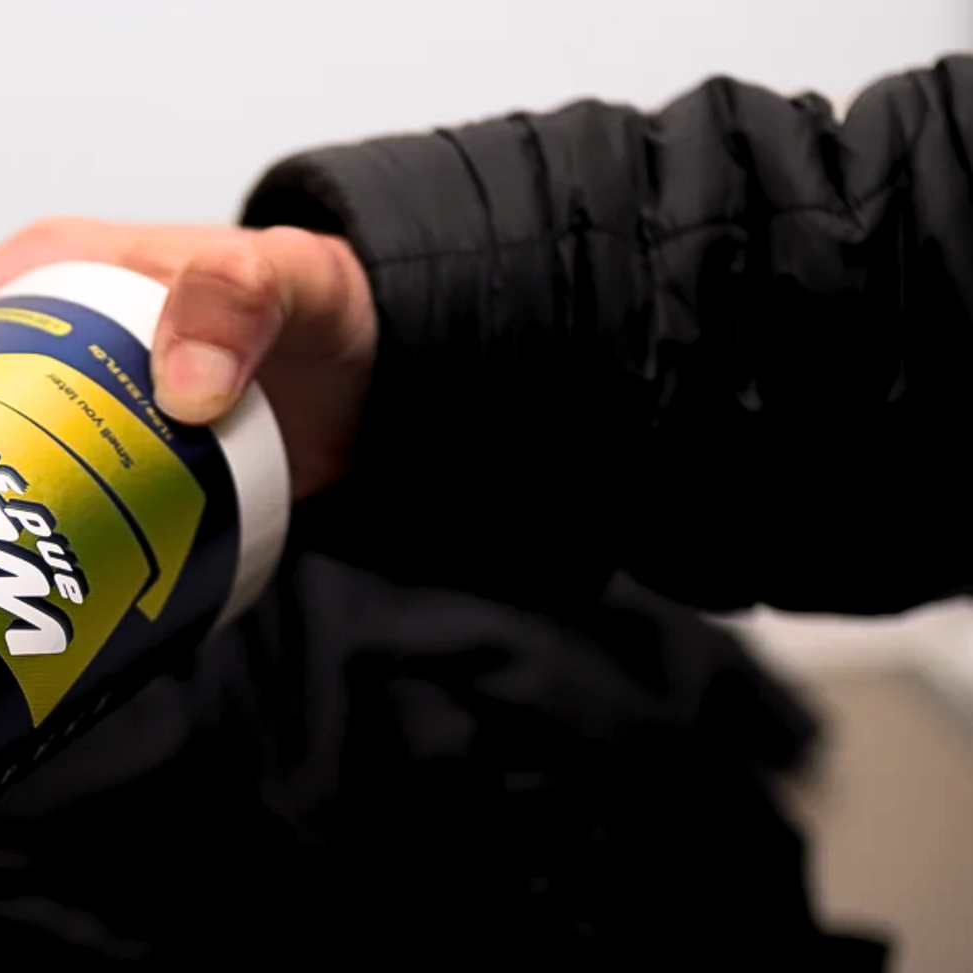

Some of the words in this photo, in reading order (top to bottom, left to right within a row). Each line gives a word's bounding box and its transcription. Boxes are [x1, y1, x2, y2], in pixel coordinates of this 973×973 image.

[46, 373, 78, 400] later
[78, 400, 105, 428] you
[100, 428, 136, 470] Smell
[3, 499, 89, 605] and
